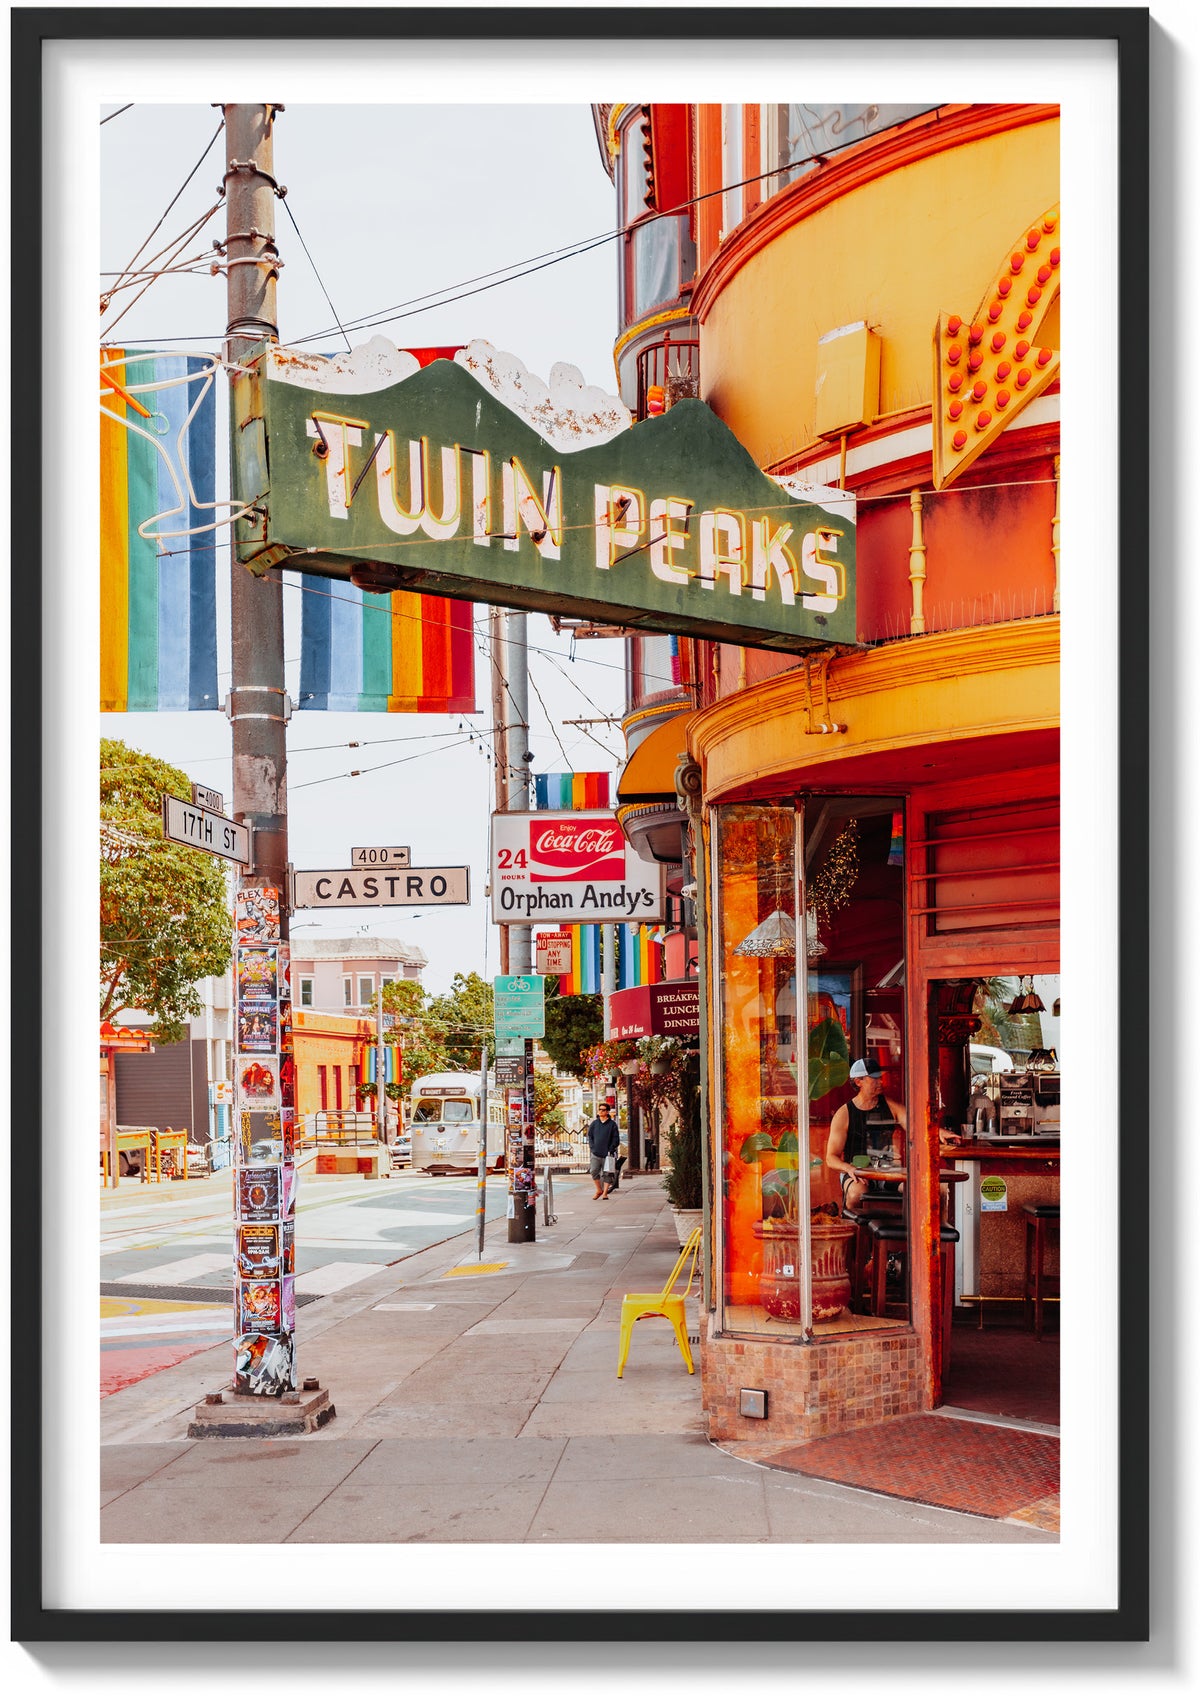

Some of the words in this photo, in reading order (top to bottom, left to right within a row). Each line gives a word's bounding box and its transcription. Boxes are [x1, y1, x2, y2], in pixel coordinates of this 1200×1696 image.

[306, 410, 562, 561] TWIN
[595, 484, 847, 614] PEAKS
[205, 791, 220, 810] 4000
[183, 811, 213, 841] 17TH
[224, 827, 237, 851] ST
[560, 824, 577, 832] Enjoy
[536, 828, 617, 853] Coca-Cola
[359, 849, 388, 863] 400
[497, 849, 528, 869] 24
[237, 889, 261, 902] FLEX
[315, 875, 447, 899] CASTRO
[501, 886, 573, 916] Orphan
[580, 884, 655, 915] Andy's
[537, 938, 547, 949] NO
[548, 941, 571, 949] STOPPING
[547, 958, 562, 966] TIME
[663, 1005, 699, 1015] LUNCH
